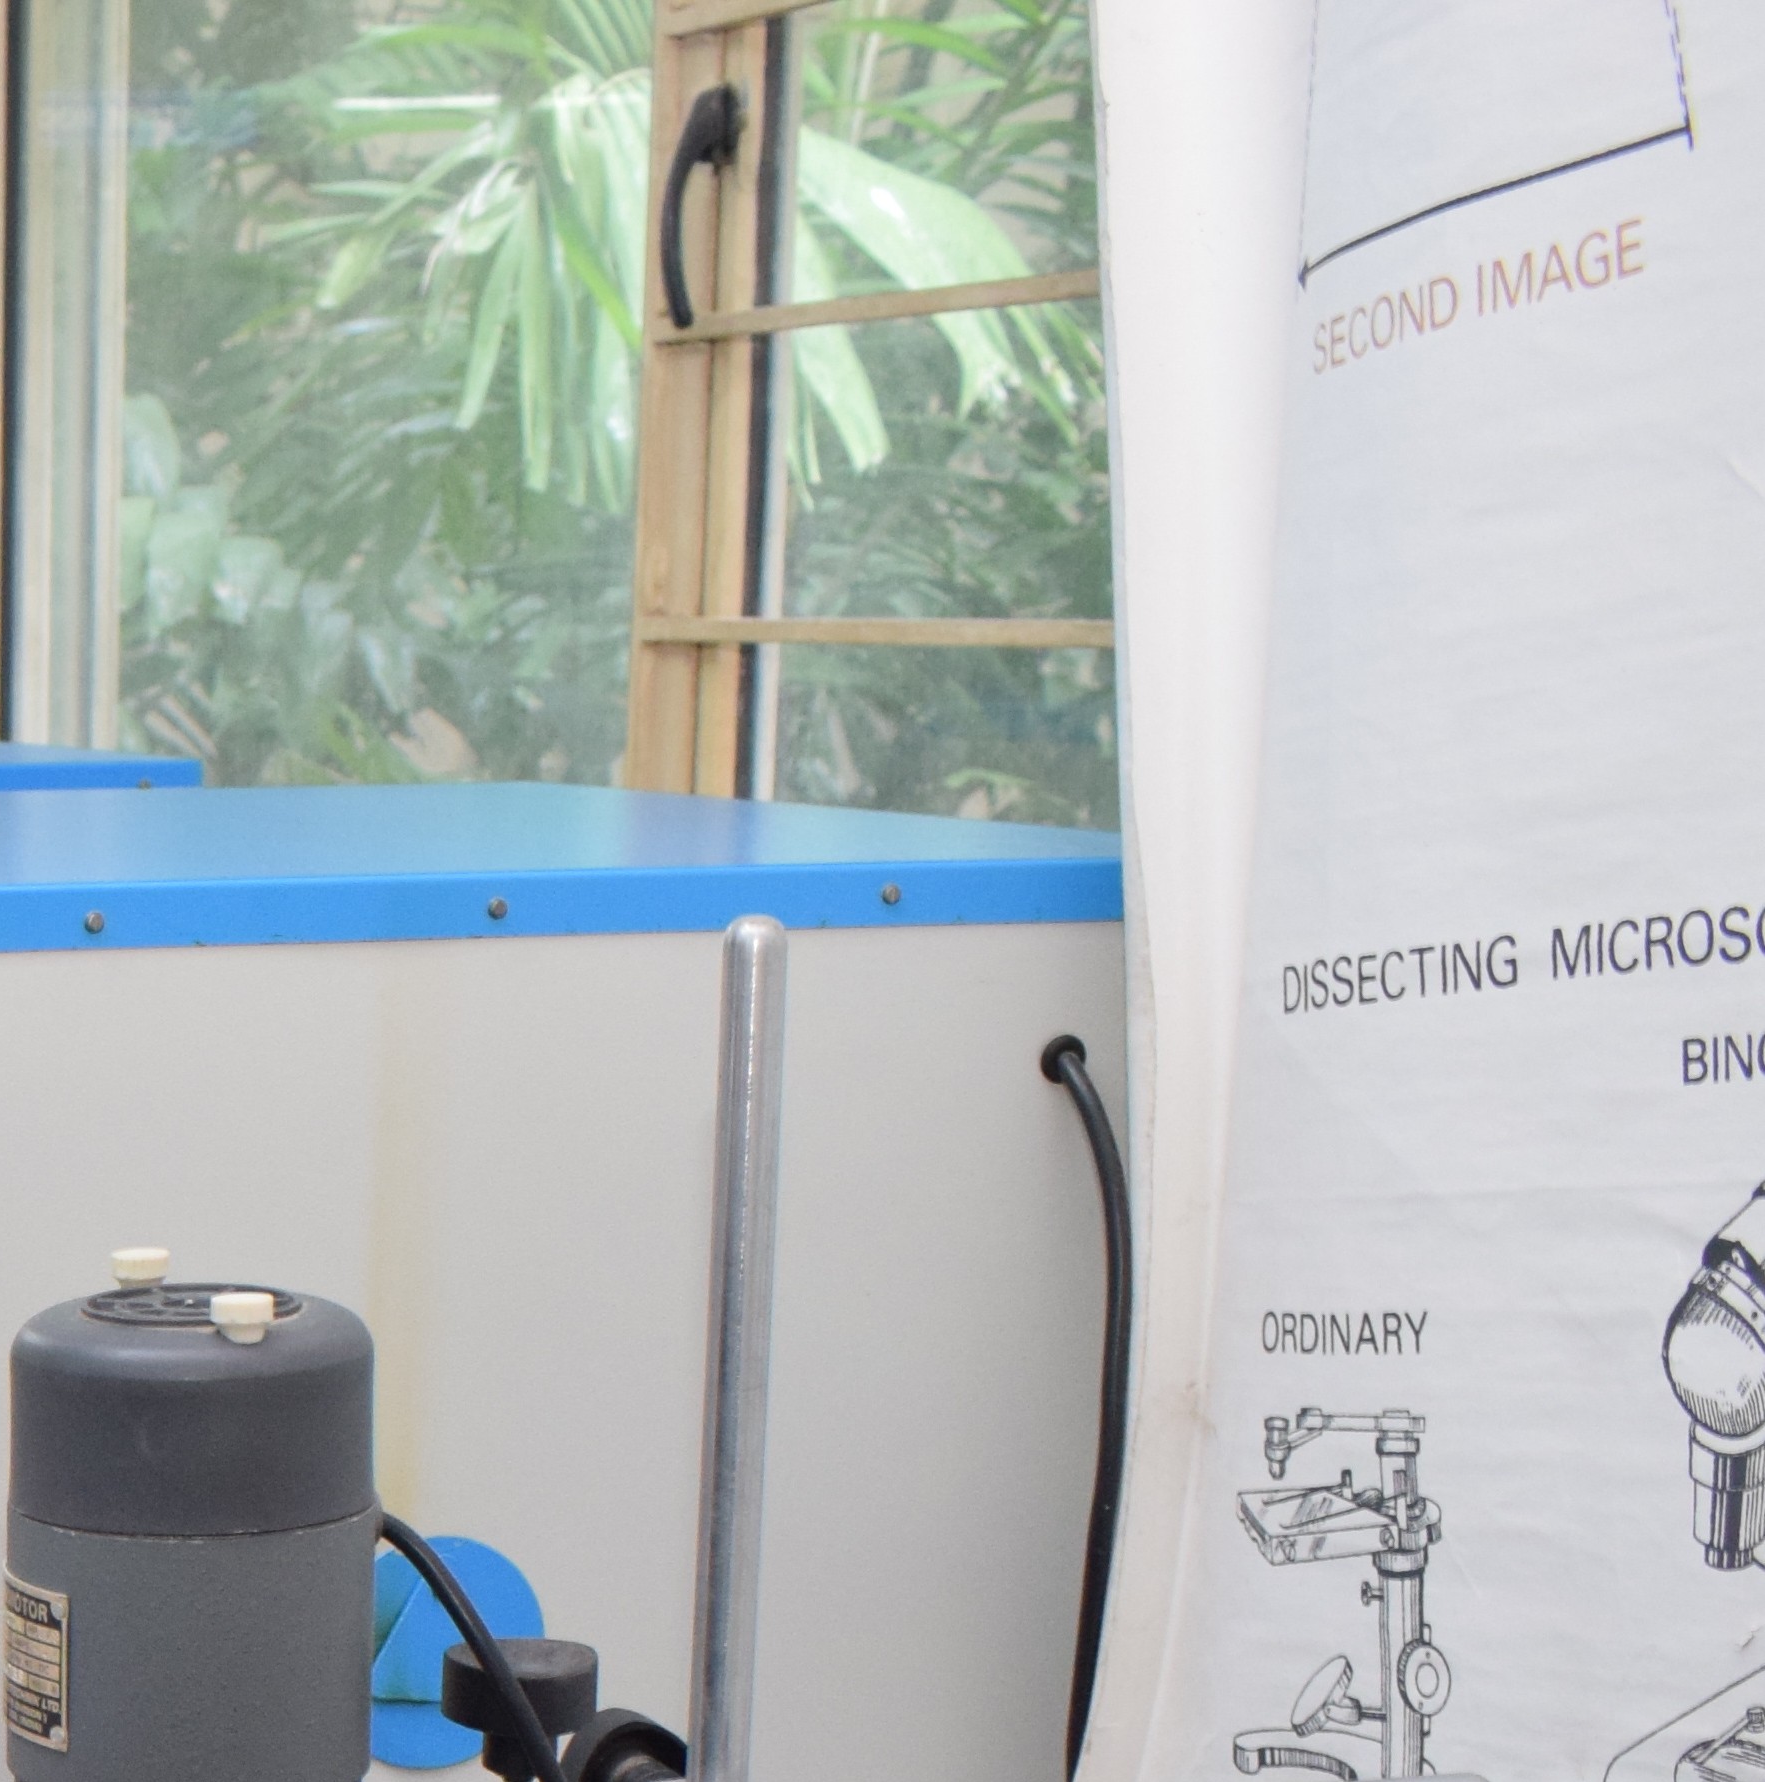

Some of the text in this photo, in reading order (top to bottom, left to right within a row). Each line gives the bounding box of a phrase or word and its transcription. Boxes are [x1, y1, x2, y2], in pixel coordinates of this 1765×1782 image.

[1312, 218, 1646, 376] SECOND IMAGE
[1282, 905, 1765, 1014] DISSECTING MICROS
[1682, 1033, 1765, 1086] BIN
[1261, 1309, 1428, 1356] ORDINARY
